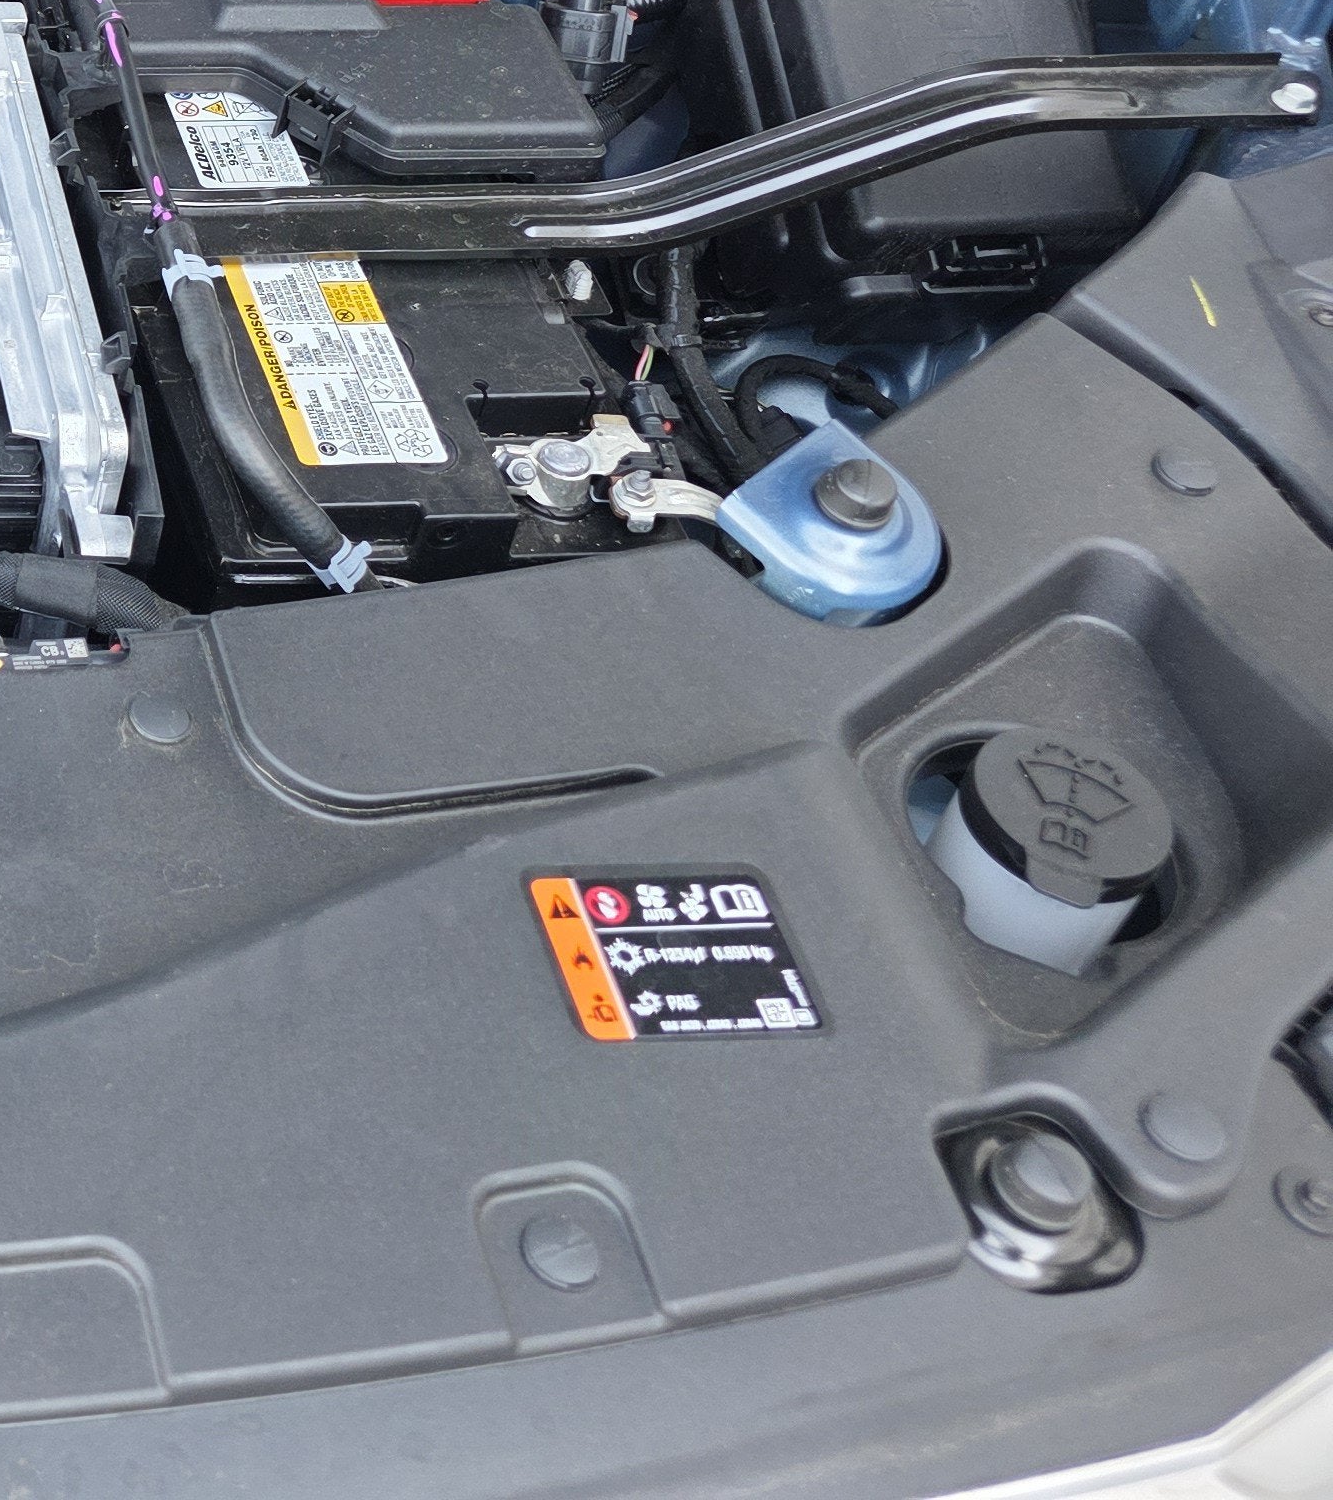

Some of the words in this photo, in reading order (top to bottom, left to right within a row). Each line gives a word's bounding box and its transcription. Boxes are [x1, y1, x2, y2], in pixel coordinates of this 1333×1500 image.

[186, 126, 216, 180] ACDelco
[220, 142, 239, 165] 9354
[243, 303, 292, 398] DANGER/POISON
[642, 907, 678, 922] AUTO
[666, 995, 701, 1011] PAG
